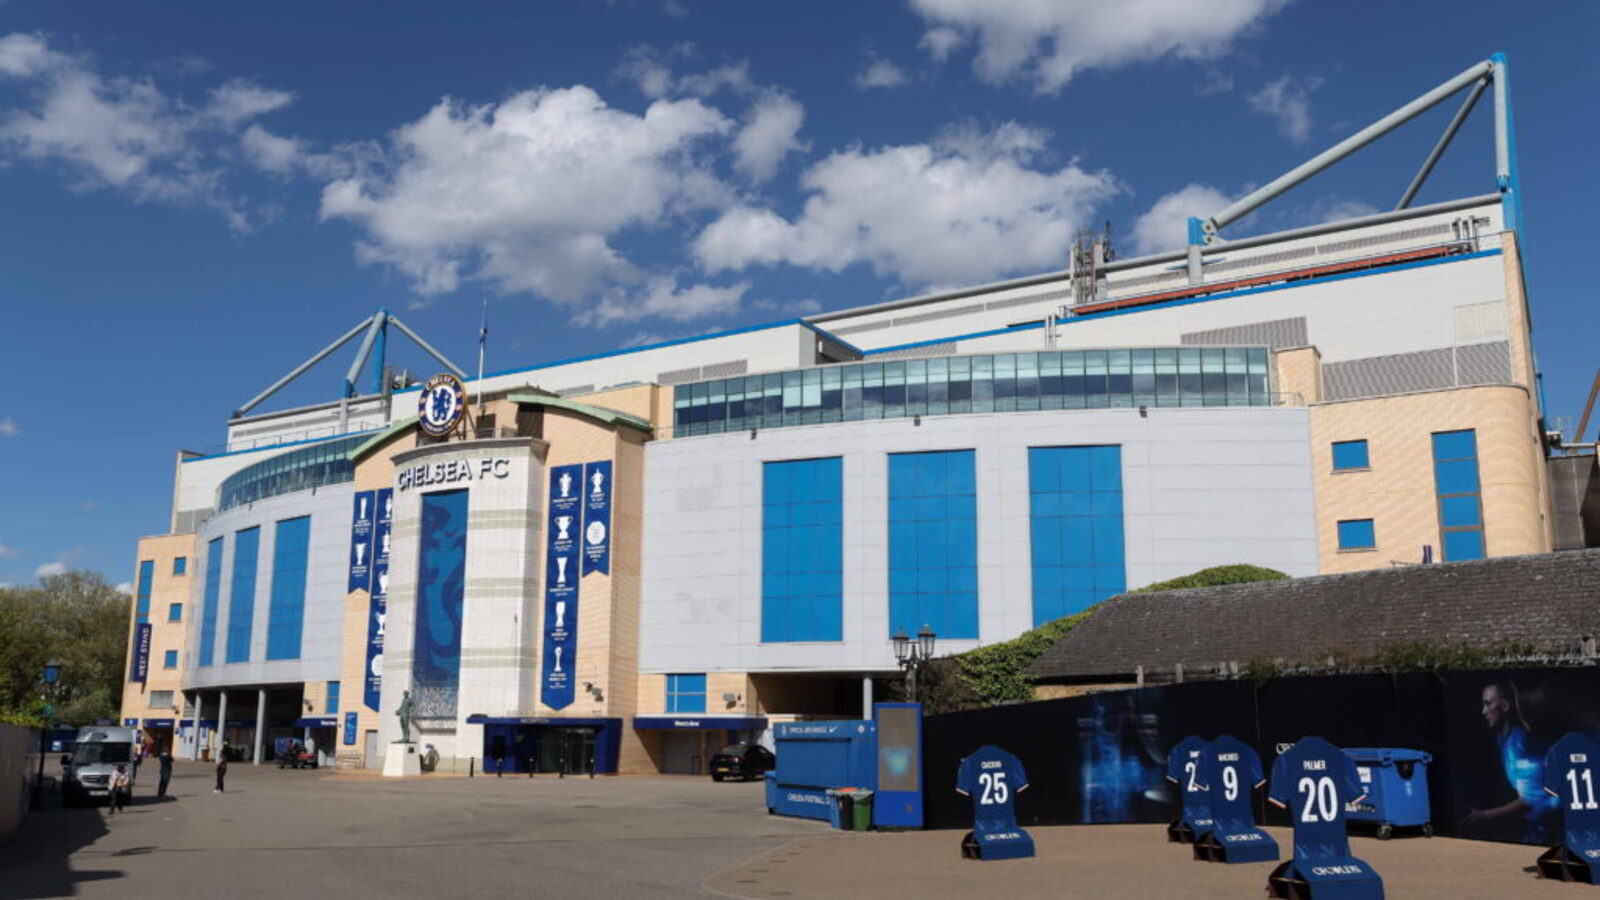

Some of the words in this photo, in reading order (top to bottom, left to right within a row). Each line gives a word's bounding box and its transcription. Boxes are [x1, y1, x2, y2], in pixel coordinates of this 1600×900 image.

[398, 459, 472, 491] CHELSEA
[479, 457, 510, 479] FC
[140, 626, 150, 654] STAND
[138, 655, 147, 678] WEST
[1303, 760, 1327, 771] PALMER
[978, 772, 1008, 805] 25
[1222, 765, 1238, 801] 9
[1298, 776, 1338, 822] 20
[1566, 769, 1598, 810] 11
